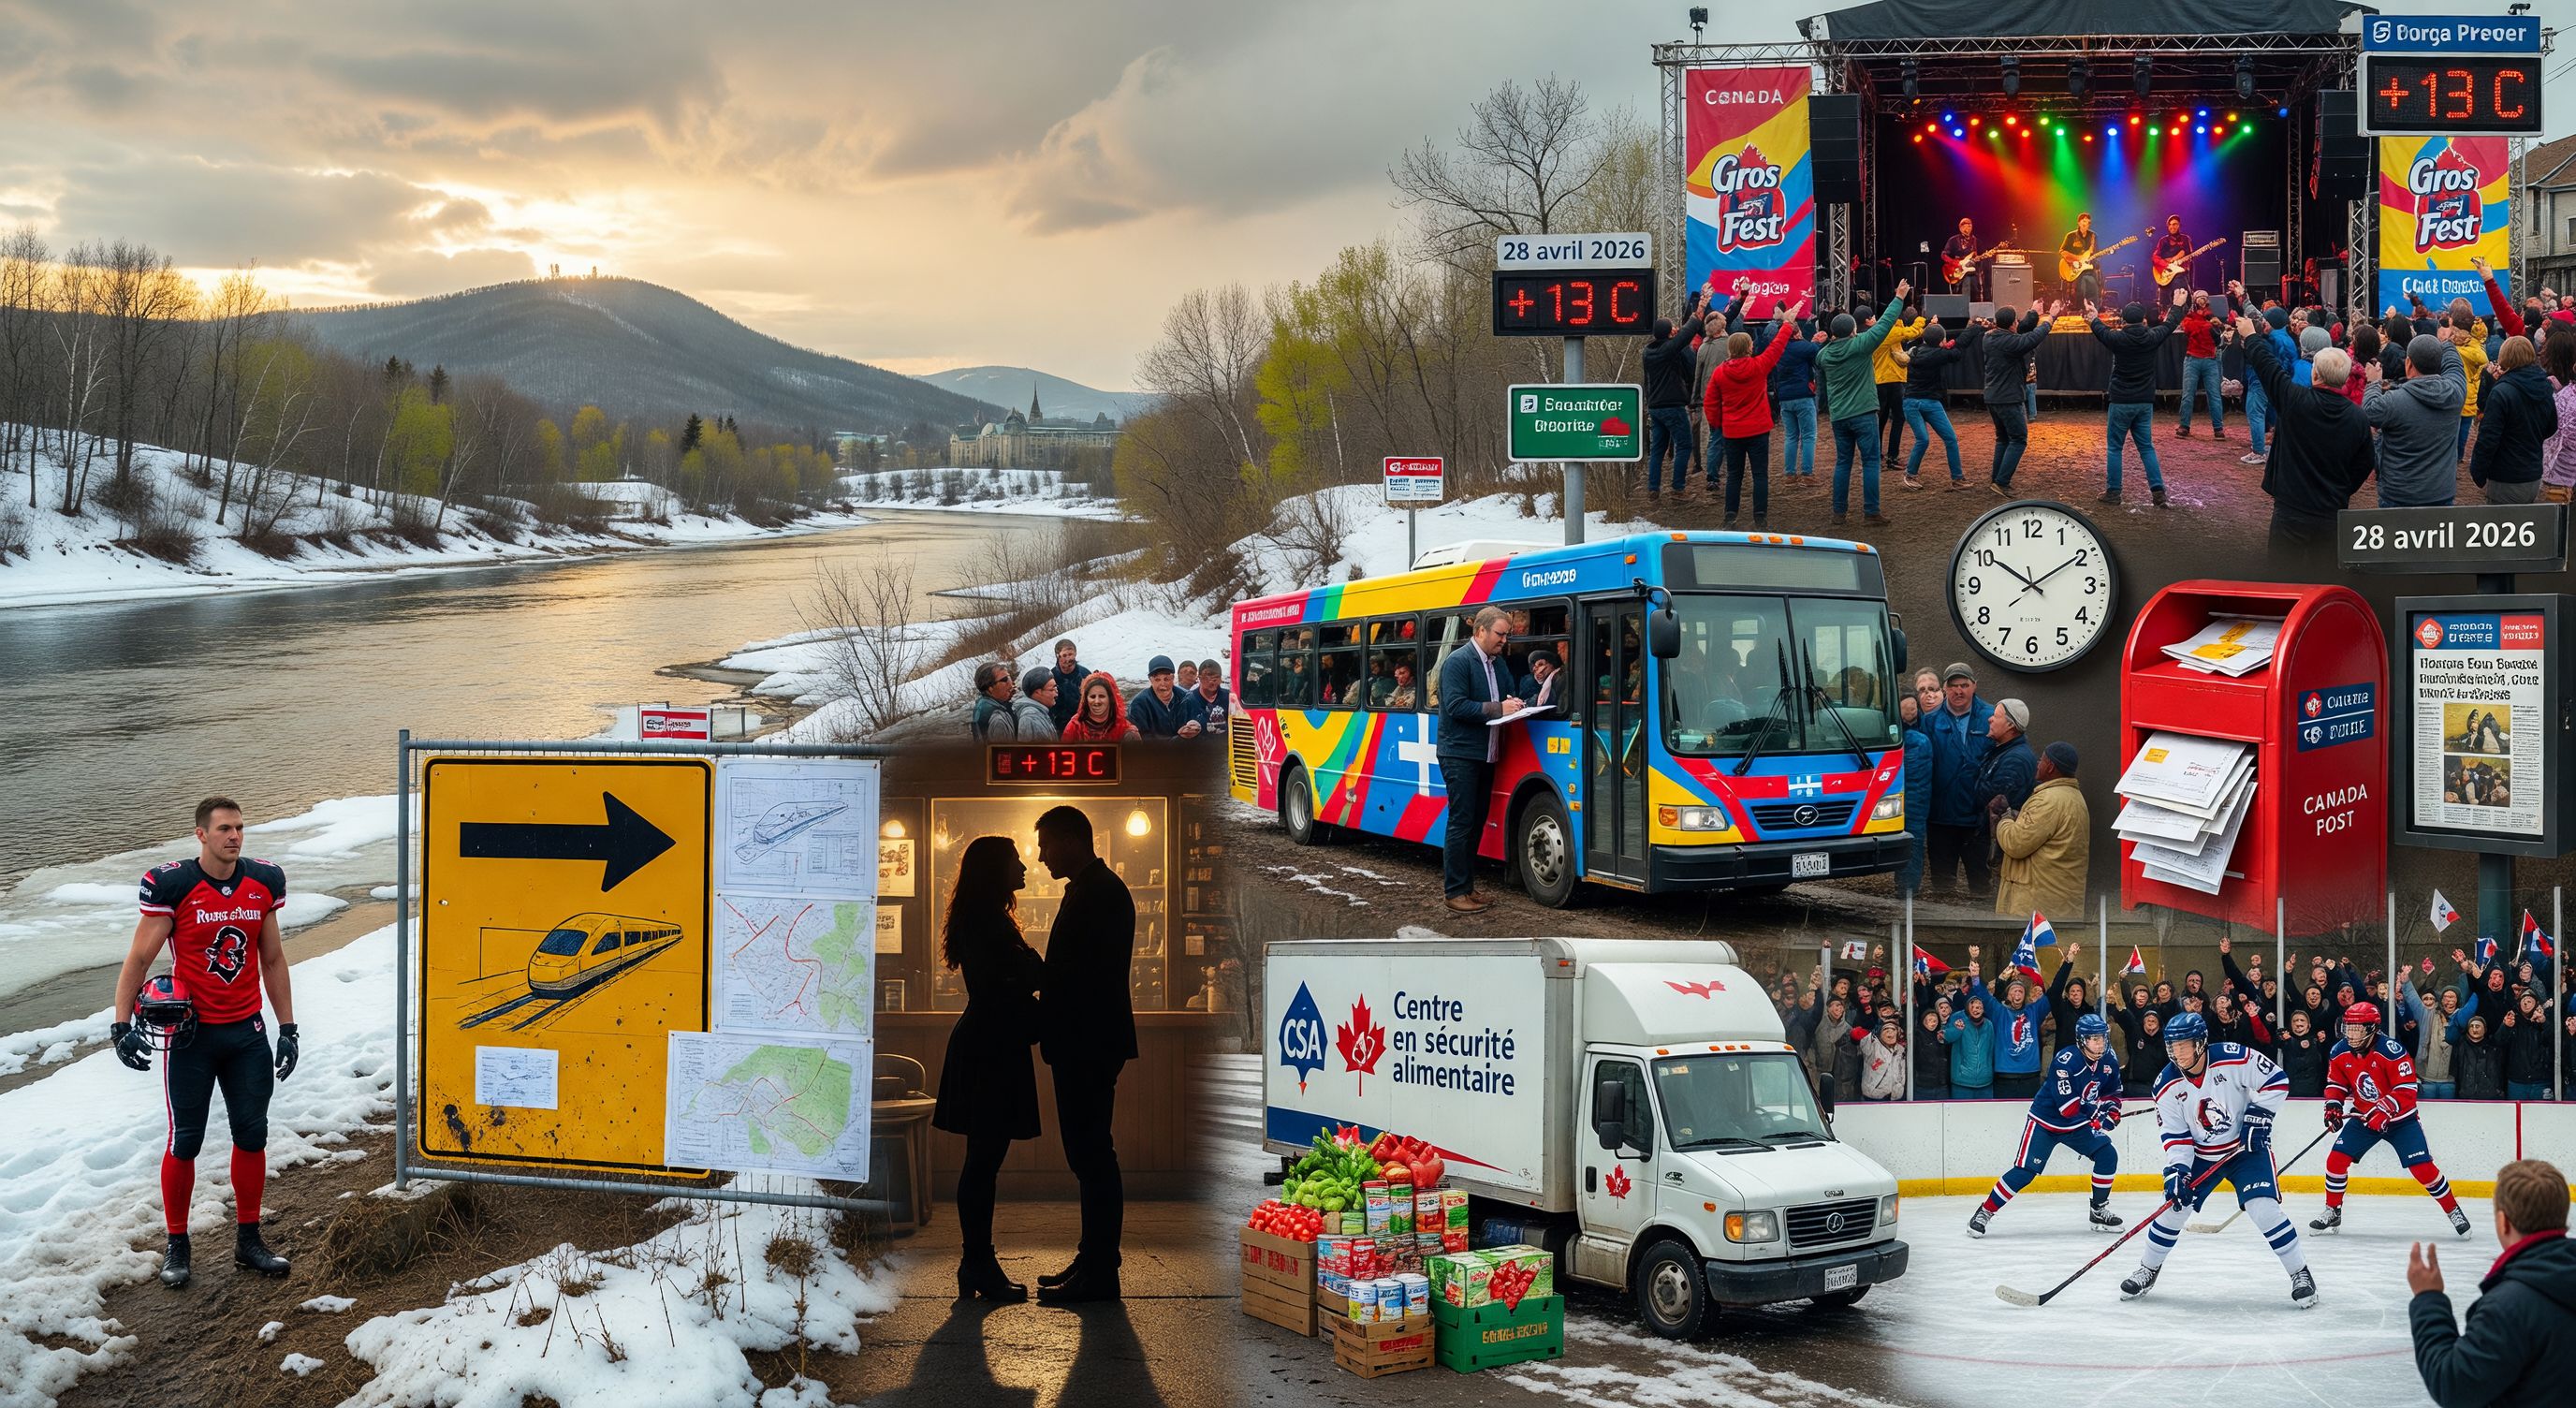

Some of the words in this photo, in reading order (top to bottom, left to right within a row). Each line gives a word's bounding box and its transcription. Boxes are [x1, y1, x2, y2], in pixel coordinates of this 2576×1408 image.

[2495, 70, 2525, 118] C
[1712, 154, 1780, 194] Gros
[2409, 157, 2476, 195] Gros
[1722, 212, 1783, 245] Fest
[2419, 212, 2480, 245] Fest
[1503, 242, 1530, 260] 28
[1536, 241, 1583, 260] avril
[1591, 241, 1645, 259] 2026
[1611, 282, 1638, 322] C
[1995, 528, 2011, 546] 11
[2022, 520, 2042, 537] 12
[2057, 528, 2064, 545] 1
[2352, 525, 2384, 550] 28
[2393, 521, 2454, 549] avril
[2466, 521, 2536, 548] 2026
[1974, 550, 1994, 566] 10
[2075, 549, 2087, 566] 2
[1969, 576, 1981, 594] 9
[2085, 577, 2096, 594] 3
[1978, 606, 1990, 624] 8
[2075, 606, 2087, 623] 4
[1998, 627, 2012, 645] 7
[2026, 637, 2038, 653] 6
[2056, 627, 2068, 645] 5
[1088, 751, 1103, 775] C
[2304, 784, 2367, 814] CANADA
[2317, 811, 2354, 836] POST
[1394, 990, 1462, 1021] Centre
[1284, 1019, 1323, 1061] CSA
[1393, 1031, 1416, 1052] en
[1425, 1026, 1515, 1060] sécurité
[1393, 1055, 1515, 1095] alimentaire
